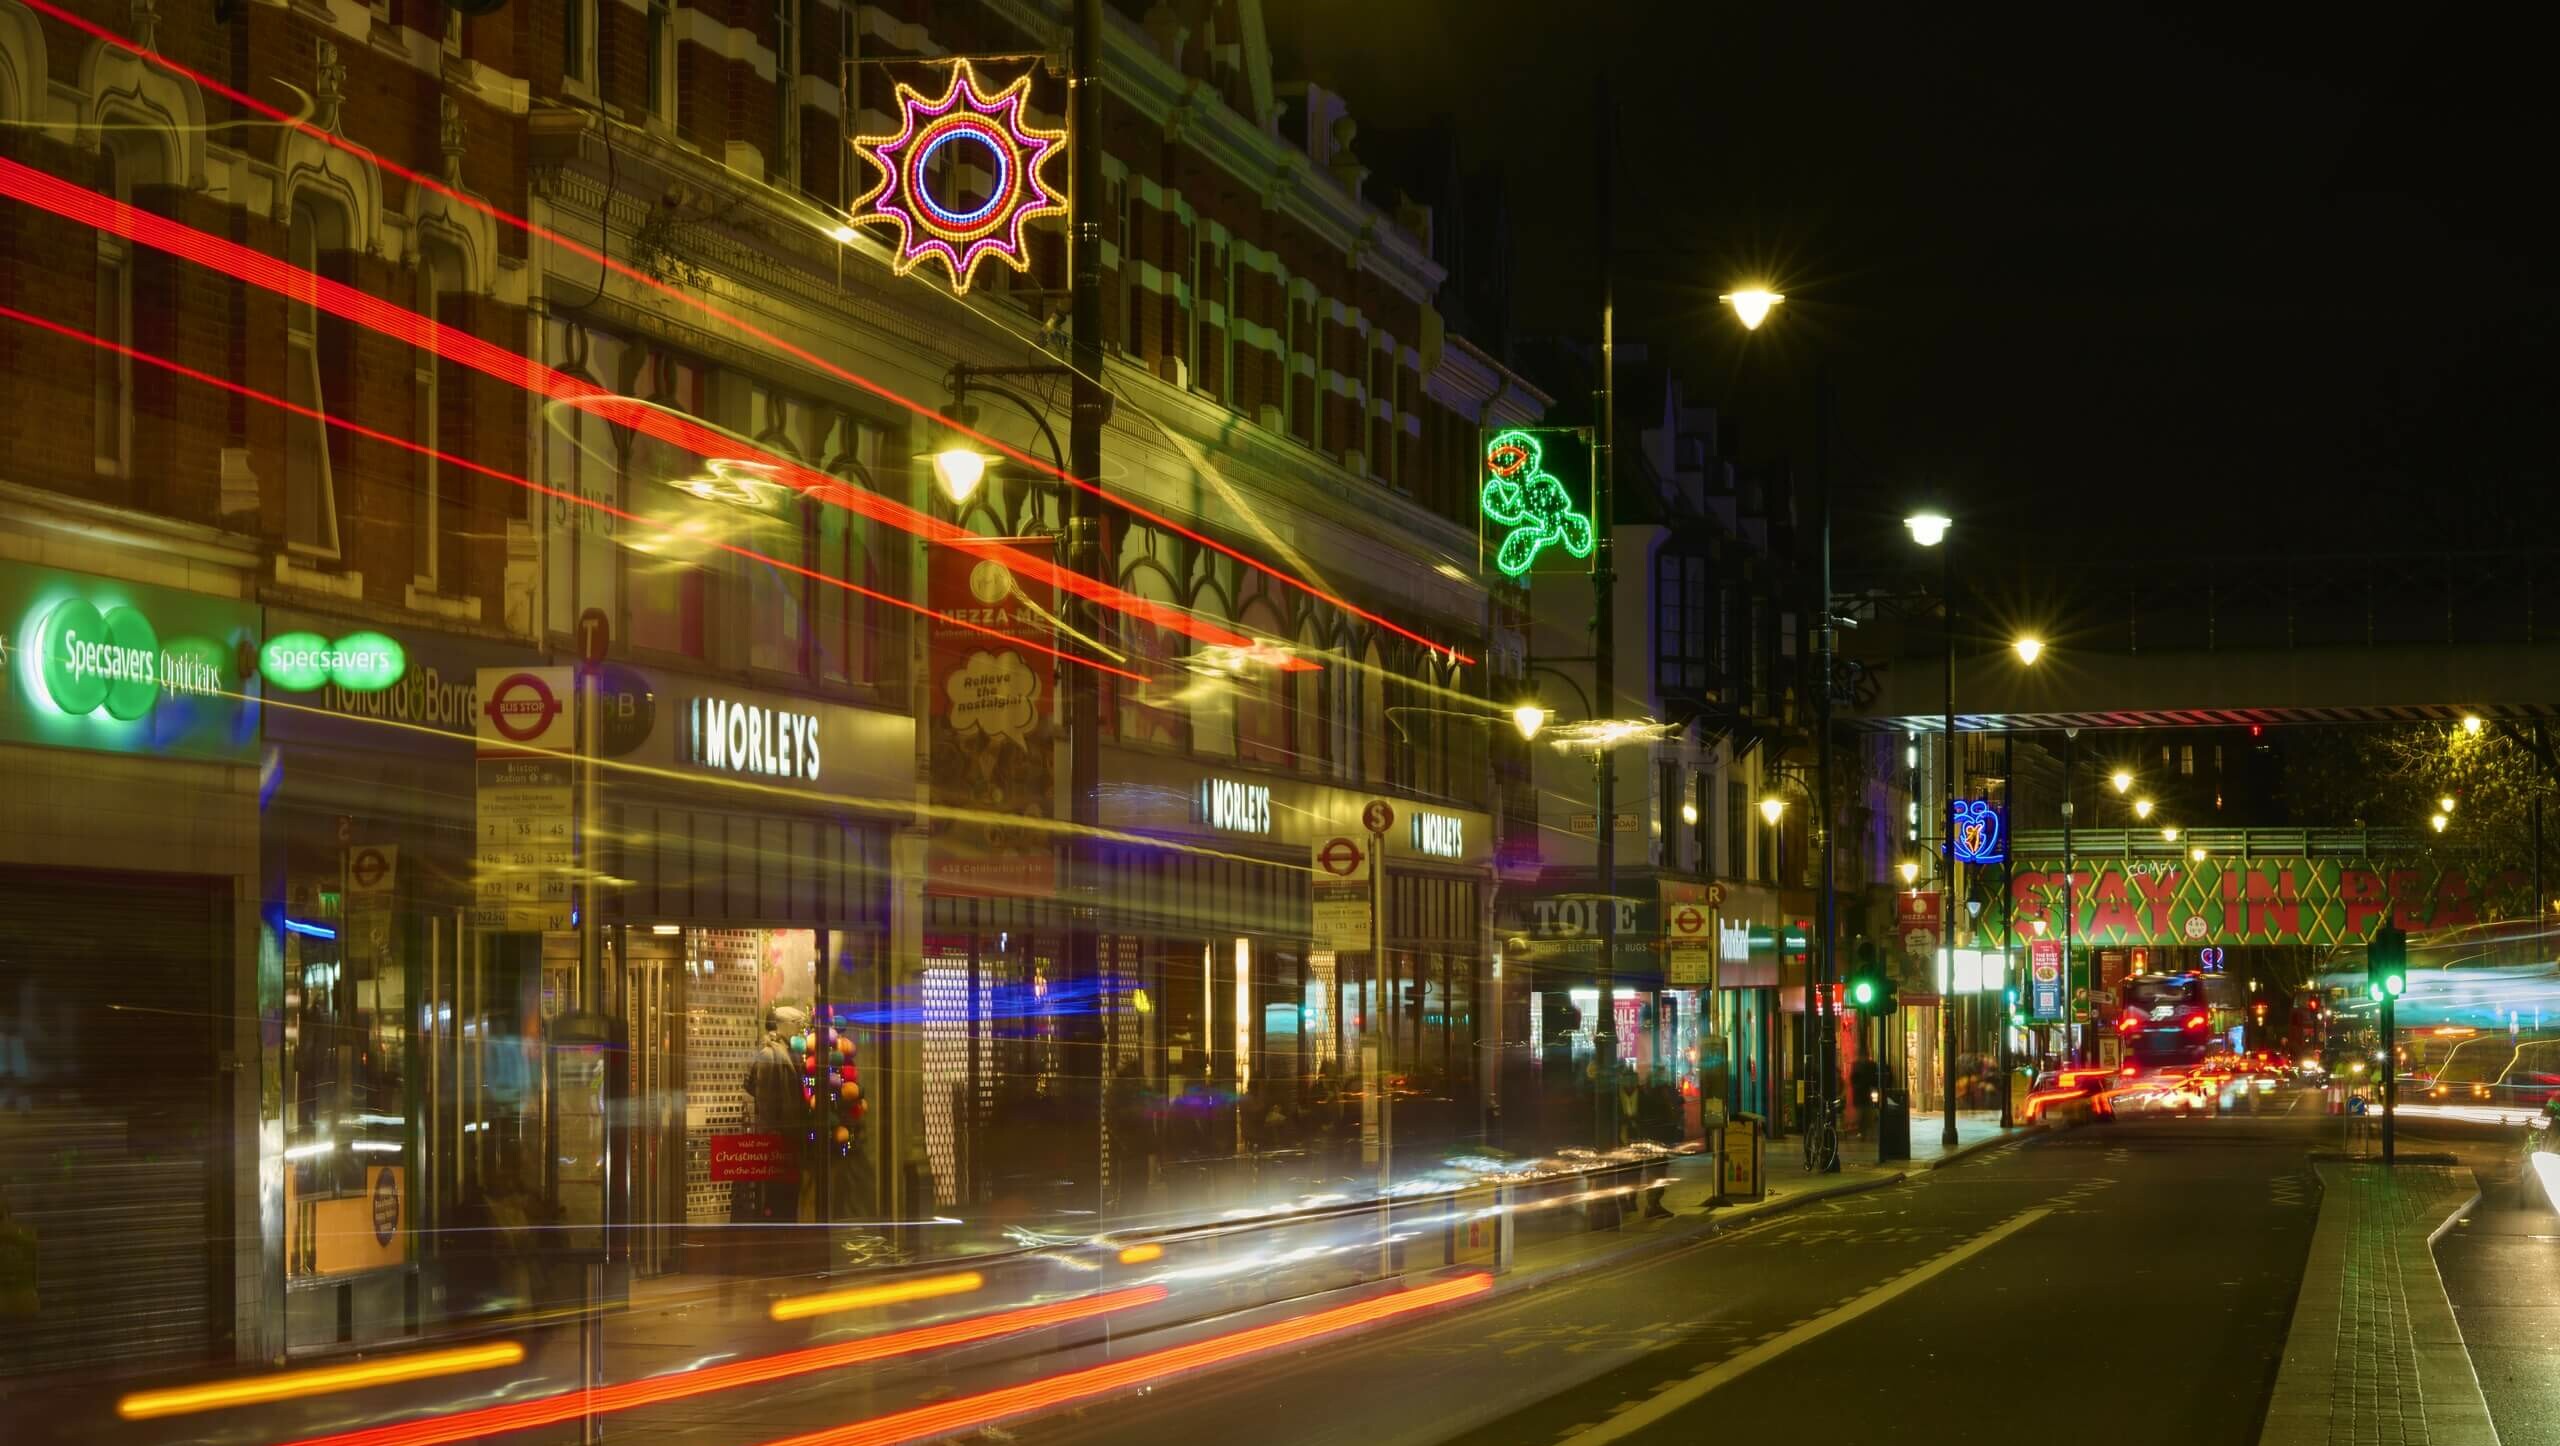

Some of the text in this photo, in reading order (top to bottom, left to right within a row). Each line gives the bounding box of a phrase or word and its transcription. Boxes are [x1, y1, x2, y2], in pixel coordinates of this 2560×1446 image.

[940, 608, 1009, 624] MEZZA
[582, 619, 600, 659] T
[65, 629, 221, 700] Specsavers Opticians
[269, 646, 390, 672] Specsavers
[977, 687, 997, 697] the
[500, 702, 545, 713] BUS STOP
[707, 697, 819, 781] MORLEYS
[1213, 778, 1270, 834] MORLEYS
[1371, 805, 1384, 827] S
[1422, 812, 1462, 858] MORLEYS
[2127, 864, 2177, 880] COMFY
[1709, 887, 1720, 902] R
[2011, 870, 2181, 934] STAY
[2222, 870, 2294, 934] IN
[1614, 1008, 1635, 1024] SALE
[716, 1151, 768, 1162] Christmas
